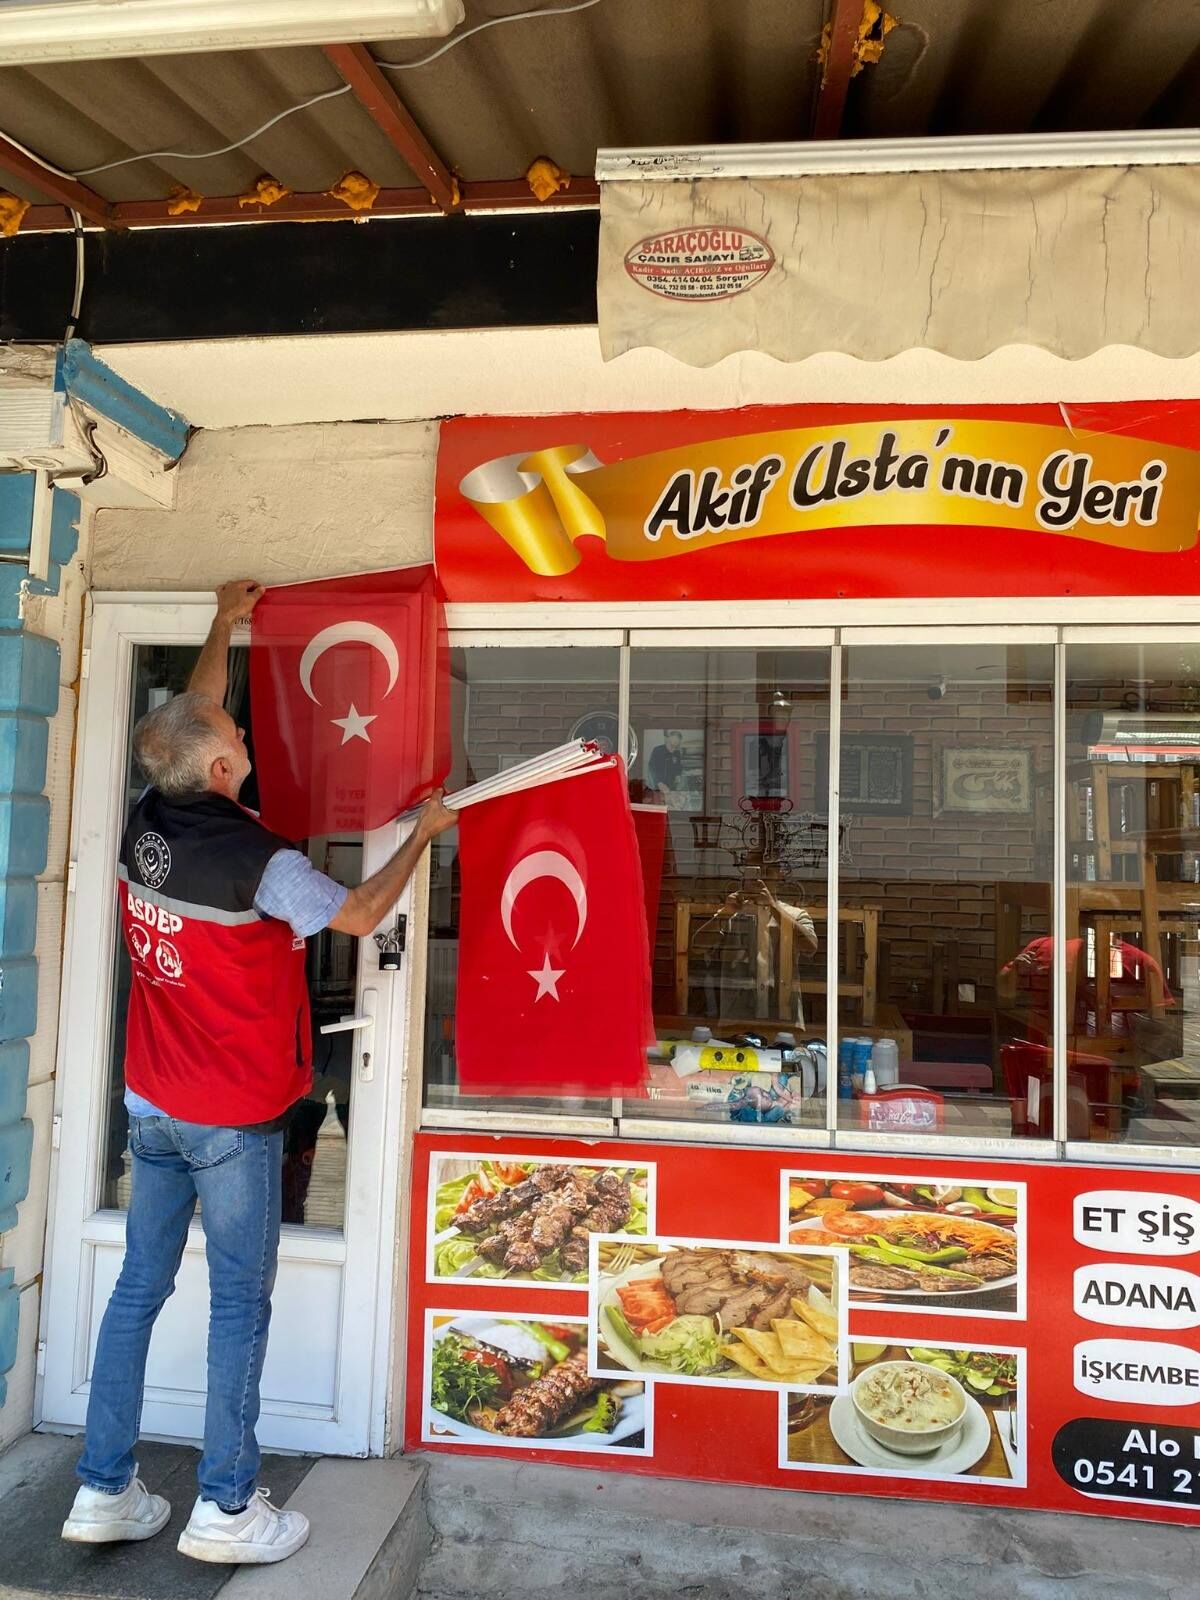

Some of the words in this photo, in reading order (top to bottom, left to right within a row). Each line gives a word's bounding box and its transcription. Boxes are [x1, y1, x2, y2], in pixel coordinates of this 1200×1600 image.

[638, 254, 680, 263] ÇADIR
[684, 251, 735, 263] SANAYİ
[716, 274, 749, 283] Sorgun
[648, 458, 782, 537] Akif
[792, 428, 1024, 507] Usta'nın
[1039, 454, 1163, 526] Yeri
[127, 892, 184, 937] ASDEP
[1082, 1206, 1126, 1233] ET
[1137, 1204, 1195, 1246] ŞİŞ
[1081, 1280, 1197, 1313] ADANA
[1081, 1355, 1199, 1387] İŞKEMBE
[1122, 1429, 1180, 1457] Alo
[1073, 1459, 1154, 1490] 0541
